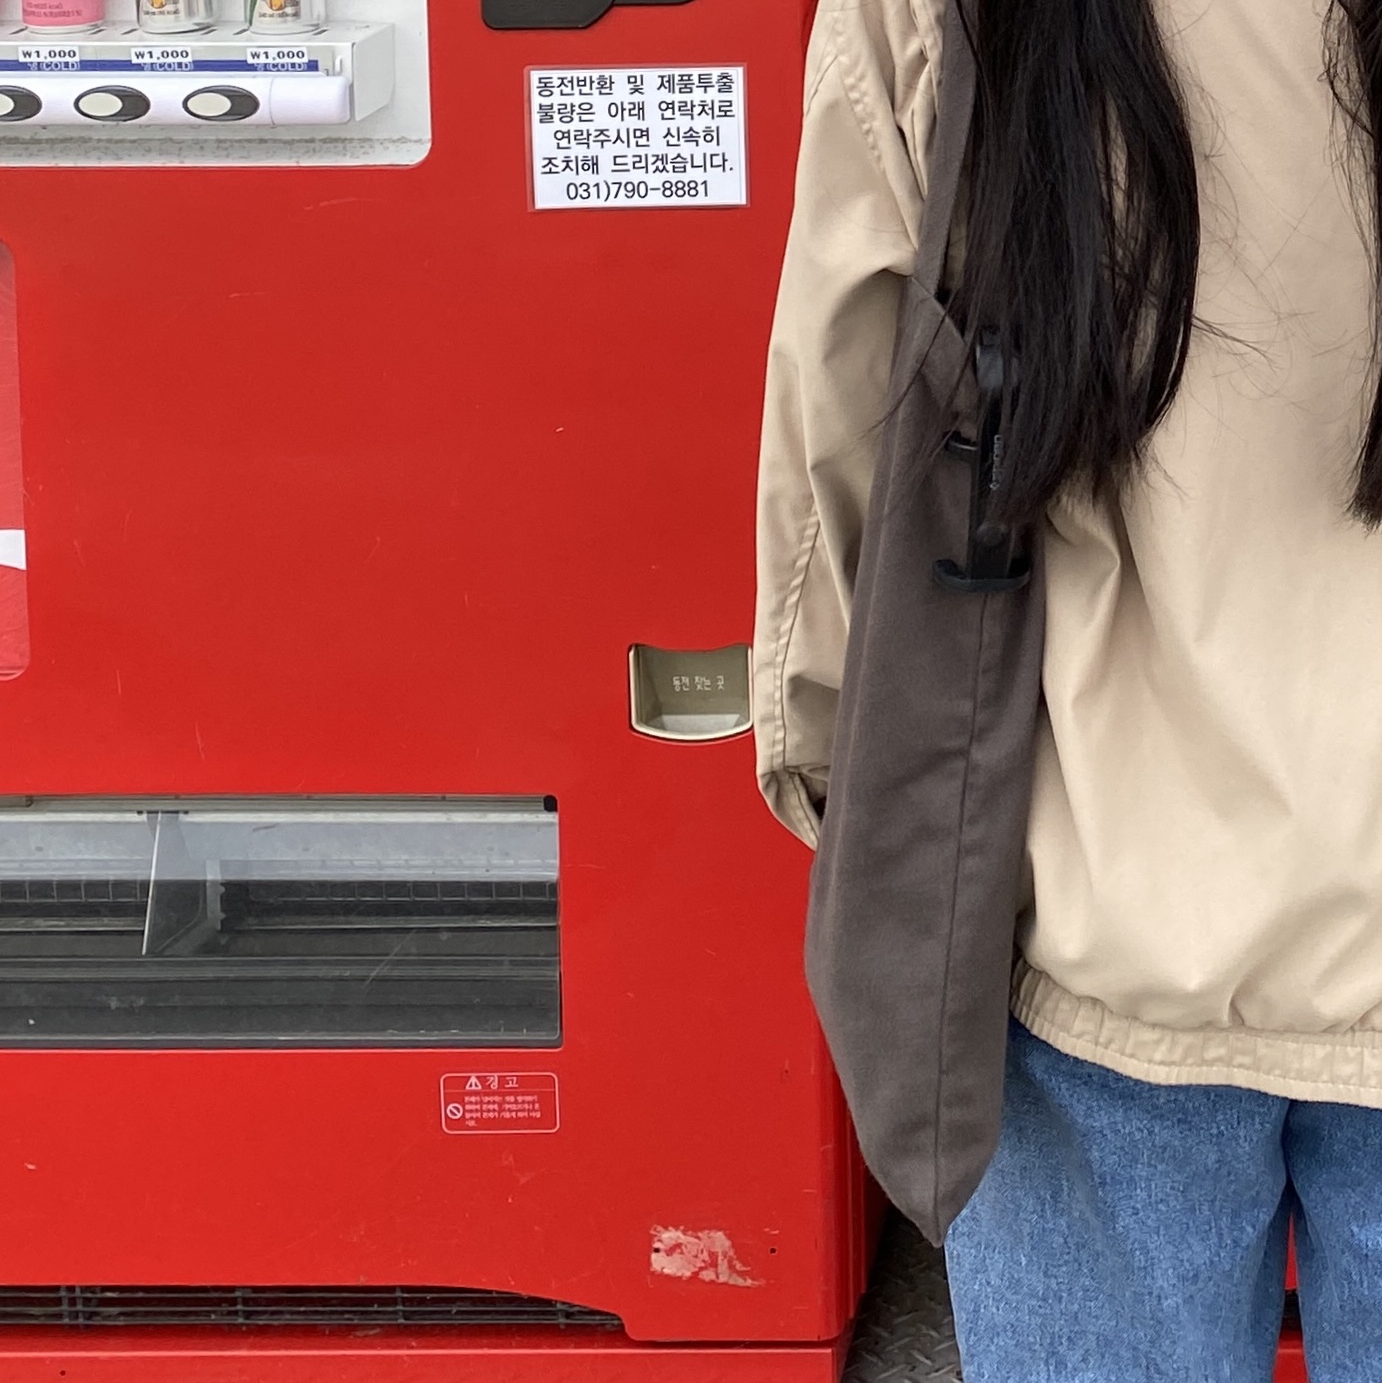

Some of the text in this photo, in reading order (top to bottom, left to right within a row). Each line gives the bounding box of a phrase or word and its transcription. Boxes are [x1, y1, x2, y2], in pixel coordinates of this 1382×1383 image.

[22, 49, 77, 60] ₩1,000
[134, 49, 189, 60] ₩1,000
[250, 49, 305, 61] ₩1,000
[536, 72, 735, 98] 동전반환 및 제품투출
[537, 99, 736, 124] 불량은 아래 연락처로
[553, 125, 720, 150] 연락주시면 신속히
[540, 151, 733, 176] 조치해 드리겠습니다.
[566, 180, 710, 202] 031)790-8881
[673, 675, 725, 692] 동전 찾는 곳
